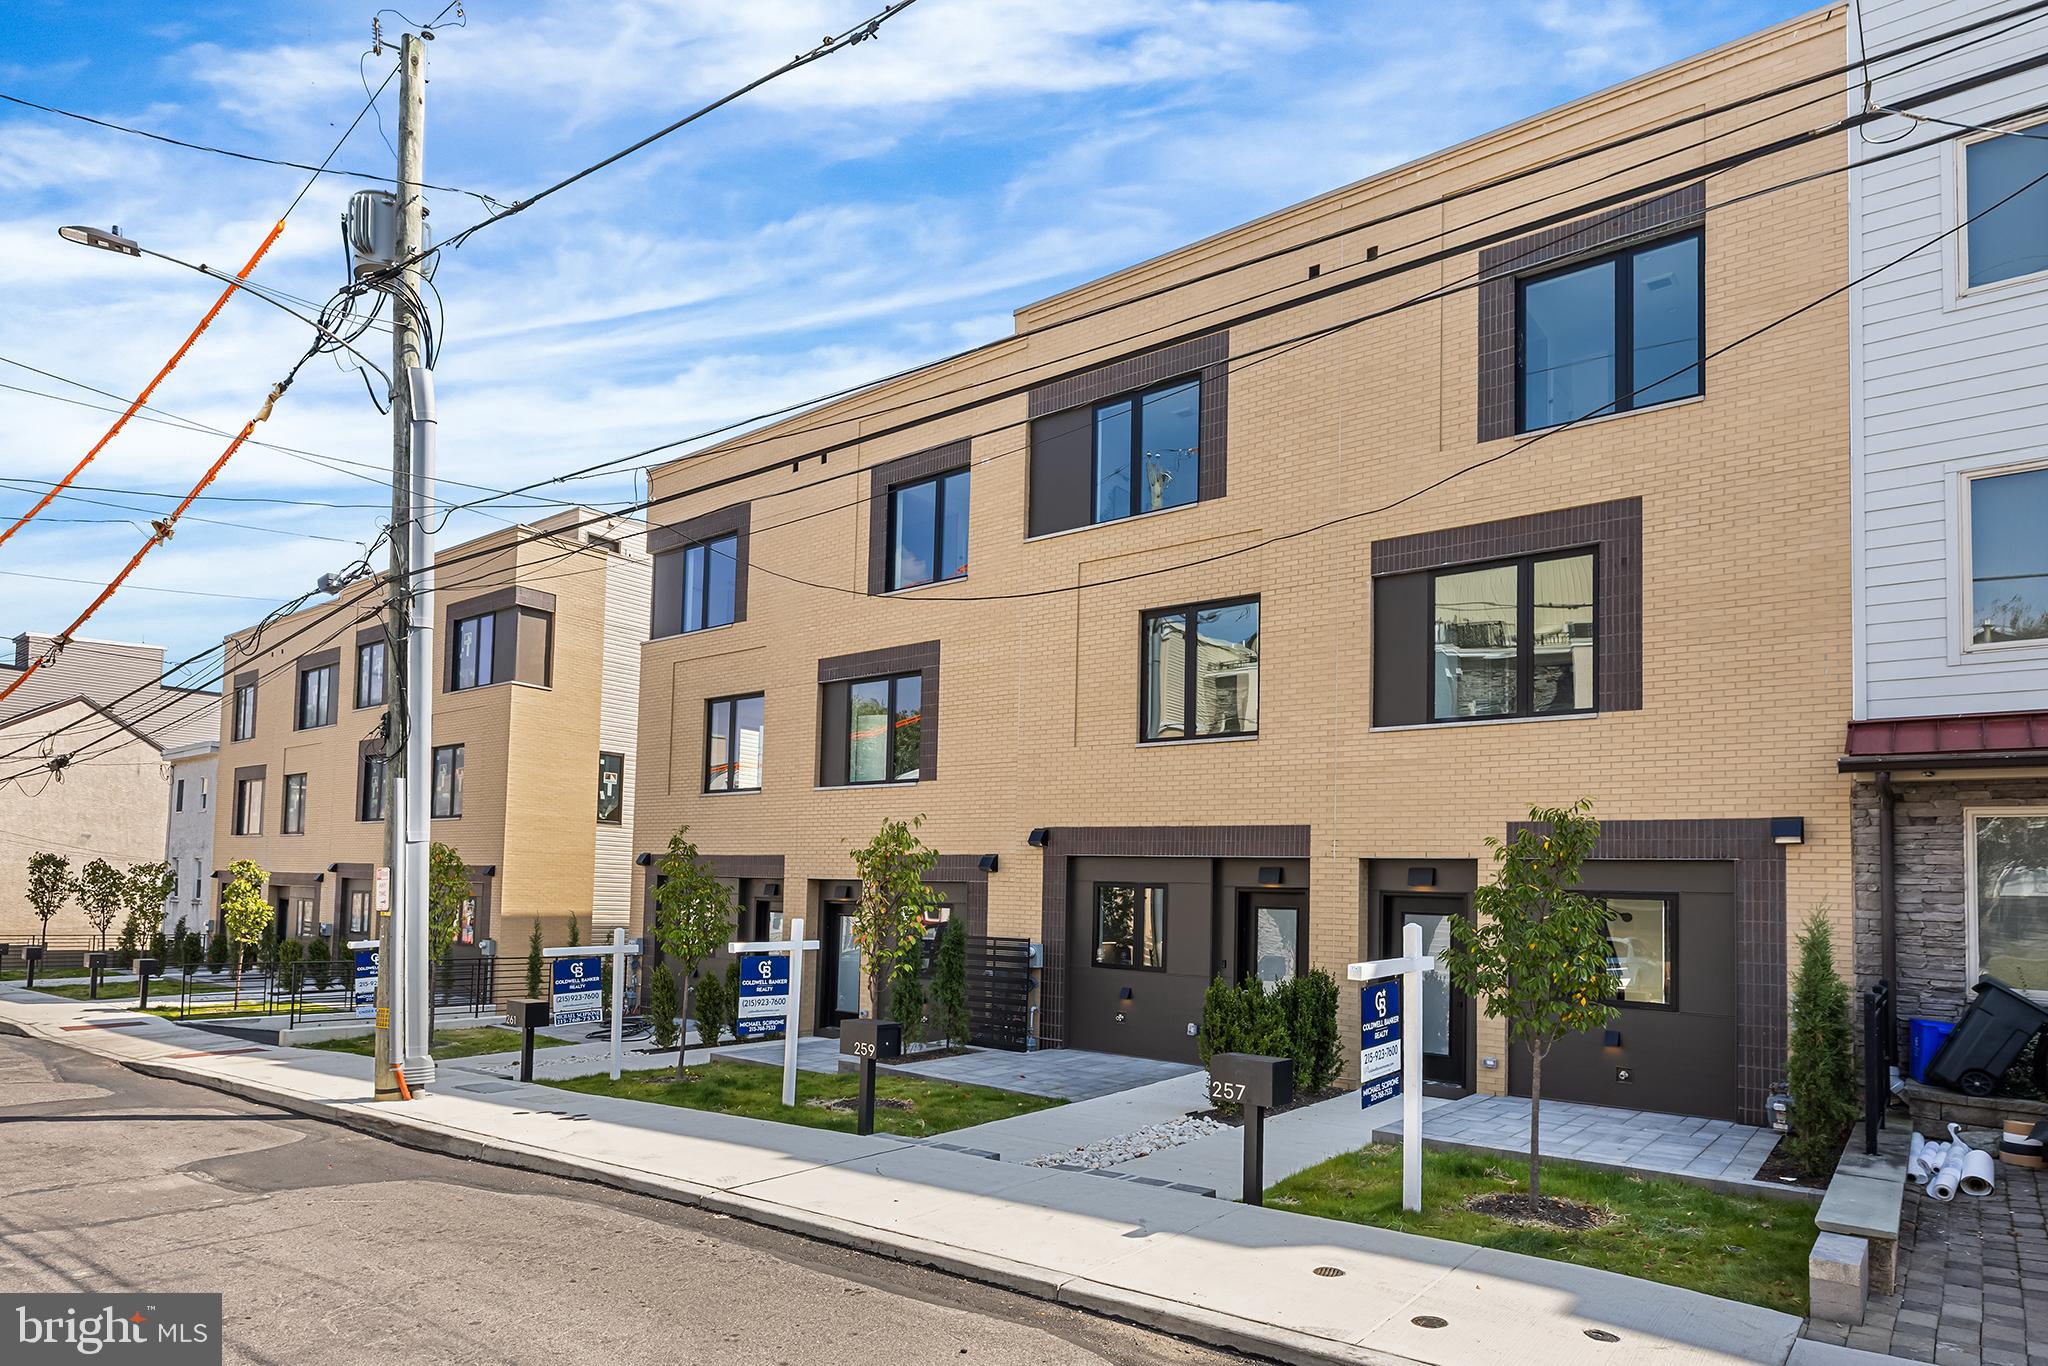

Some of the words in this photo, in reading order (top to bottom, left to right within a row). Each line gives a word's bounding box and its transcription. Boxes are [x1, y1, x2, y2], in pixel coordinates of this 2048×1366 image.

[359, 980, 378, 988] 215-92
[506, 1014, 517, 1025] 261
[739, 1020, 761, 1028] MICHAEL
[1362, 1020, 1384, 1031] COLDWELL
[1384, 1015, 1400, 1026] BANKER
[1374, 1029, 1389, 1039] REALTY
[854, 1041, 875, 1057] 259
[1364, 1044, 1399, 1065] 215-923-7600
[1212, 1081, 1246, 1100] 257
[1363, 1084, 1382, 1097] MICHAEL
